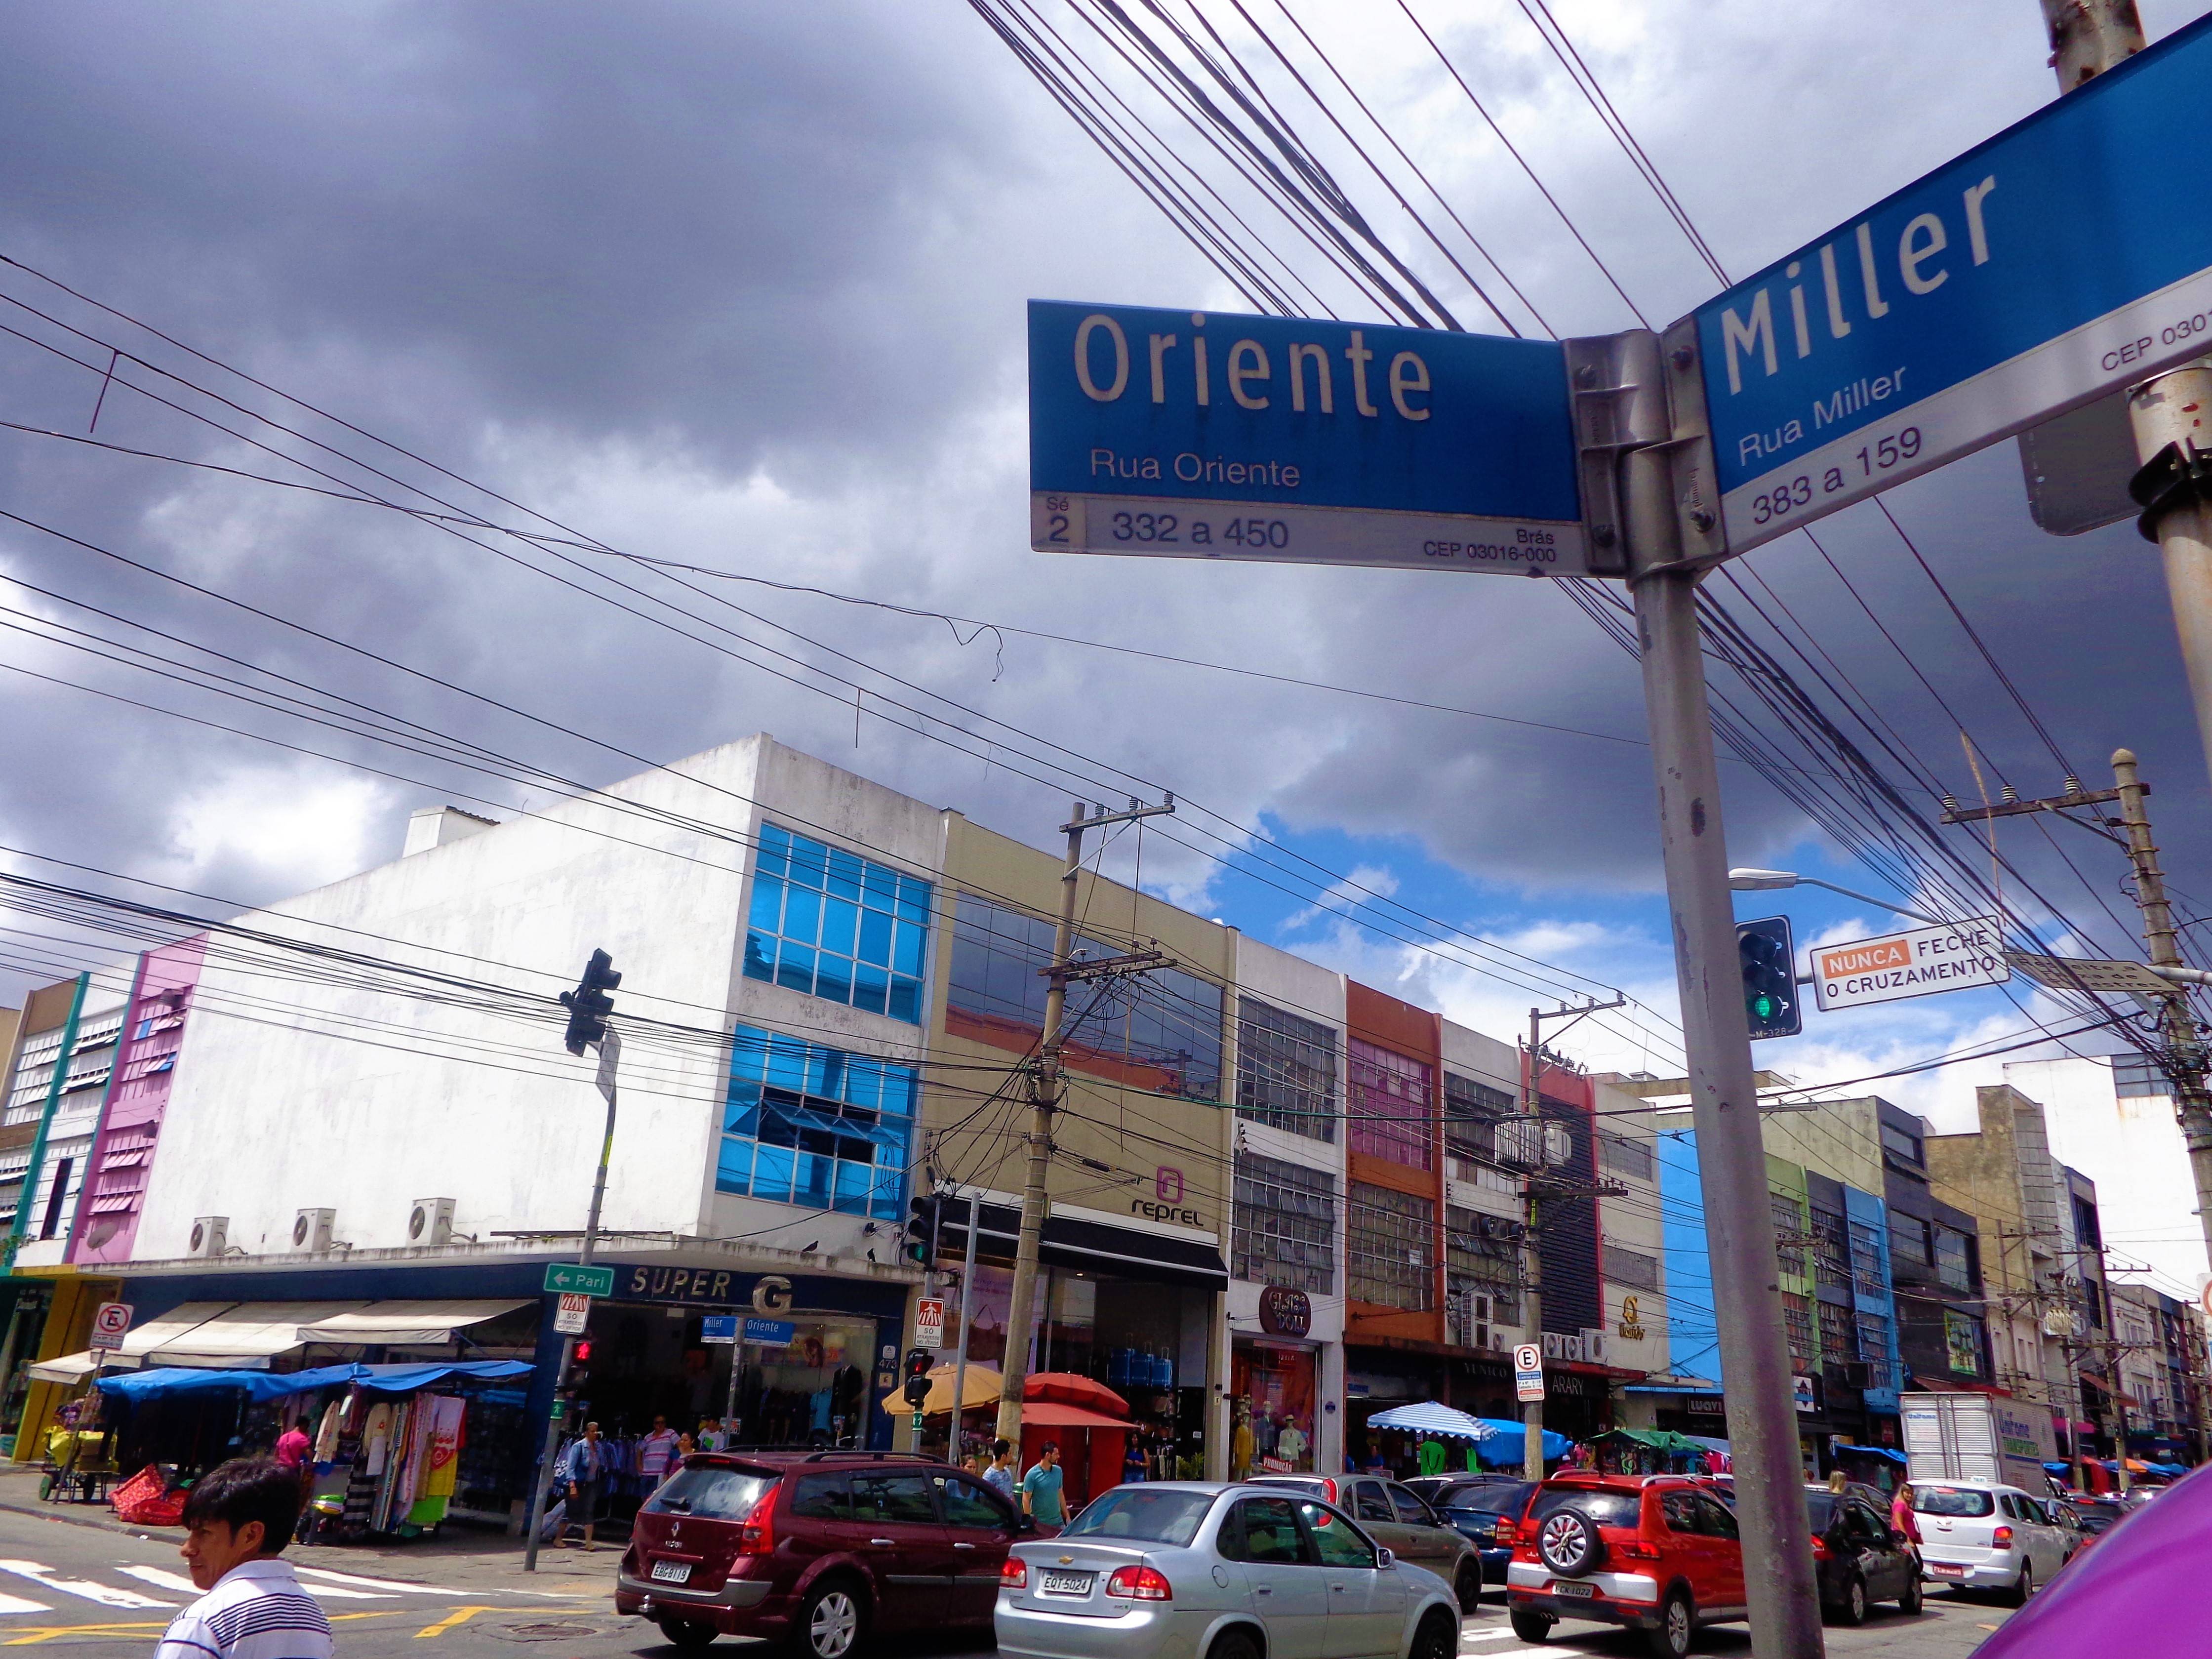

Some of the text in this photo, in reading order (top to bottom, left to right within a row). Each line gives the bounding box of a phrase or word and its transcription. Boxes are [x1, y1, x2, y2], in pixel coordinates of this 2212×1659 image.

[1722, 174, 1997, 395] Miller
[1074, 312, 1431, 422] Oriente
[2102, 336, 2153, 370] CEP
[1739, 366, 1906, 467] Rua Miller
[1091, 448, 1301, 488] Rua Oriente
[1753, 427, 1922, 525] 383 a 159
[1046, 496, 1069, 511] Sé
[1049, 515, 1069, 543] 2
[1112, 512, 1289, 549] 332 a 450
[1516, 528, 1554, 544] Brás
[1423, 541, 1556, 562] CEP 03016-000
[1829, 930, 1991, 973] NUNCA FECHE
[1826, 956, 1996, 998] O CRUZAMENTO
[1131, 1198, 1204, 1227] reprel
[575, 1274, 605, 1289] Pari
[631, 1266, 792, 1318] SUPER G
[704, 1318, 723, 1328] Miller
[746, 1319, 779, 1333] Oriente
[878, 1358, 897, 1370] 473
[1523, 1351, 1532, 1366] E
[1553, 1375, 1584, 1396] ARARY
[1263, 1457, 1292, 1473] PROMOÇÃO
[1044, 1577, 1087, 1592] EQT-5024
